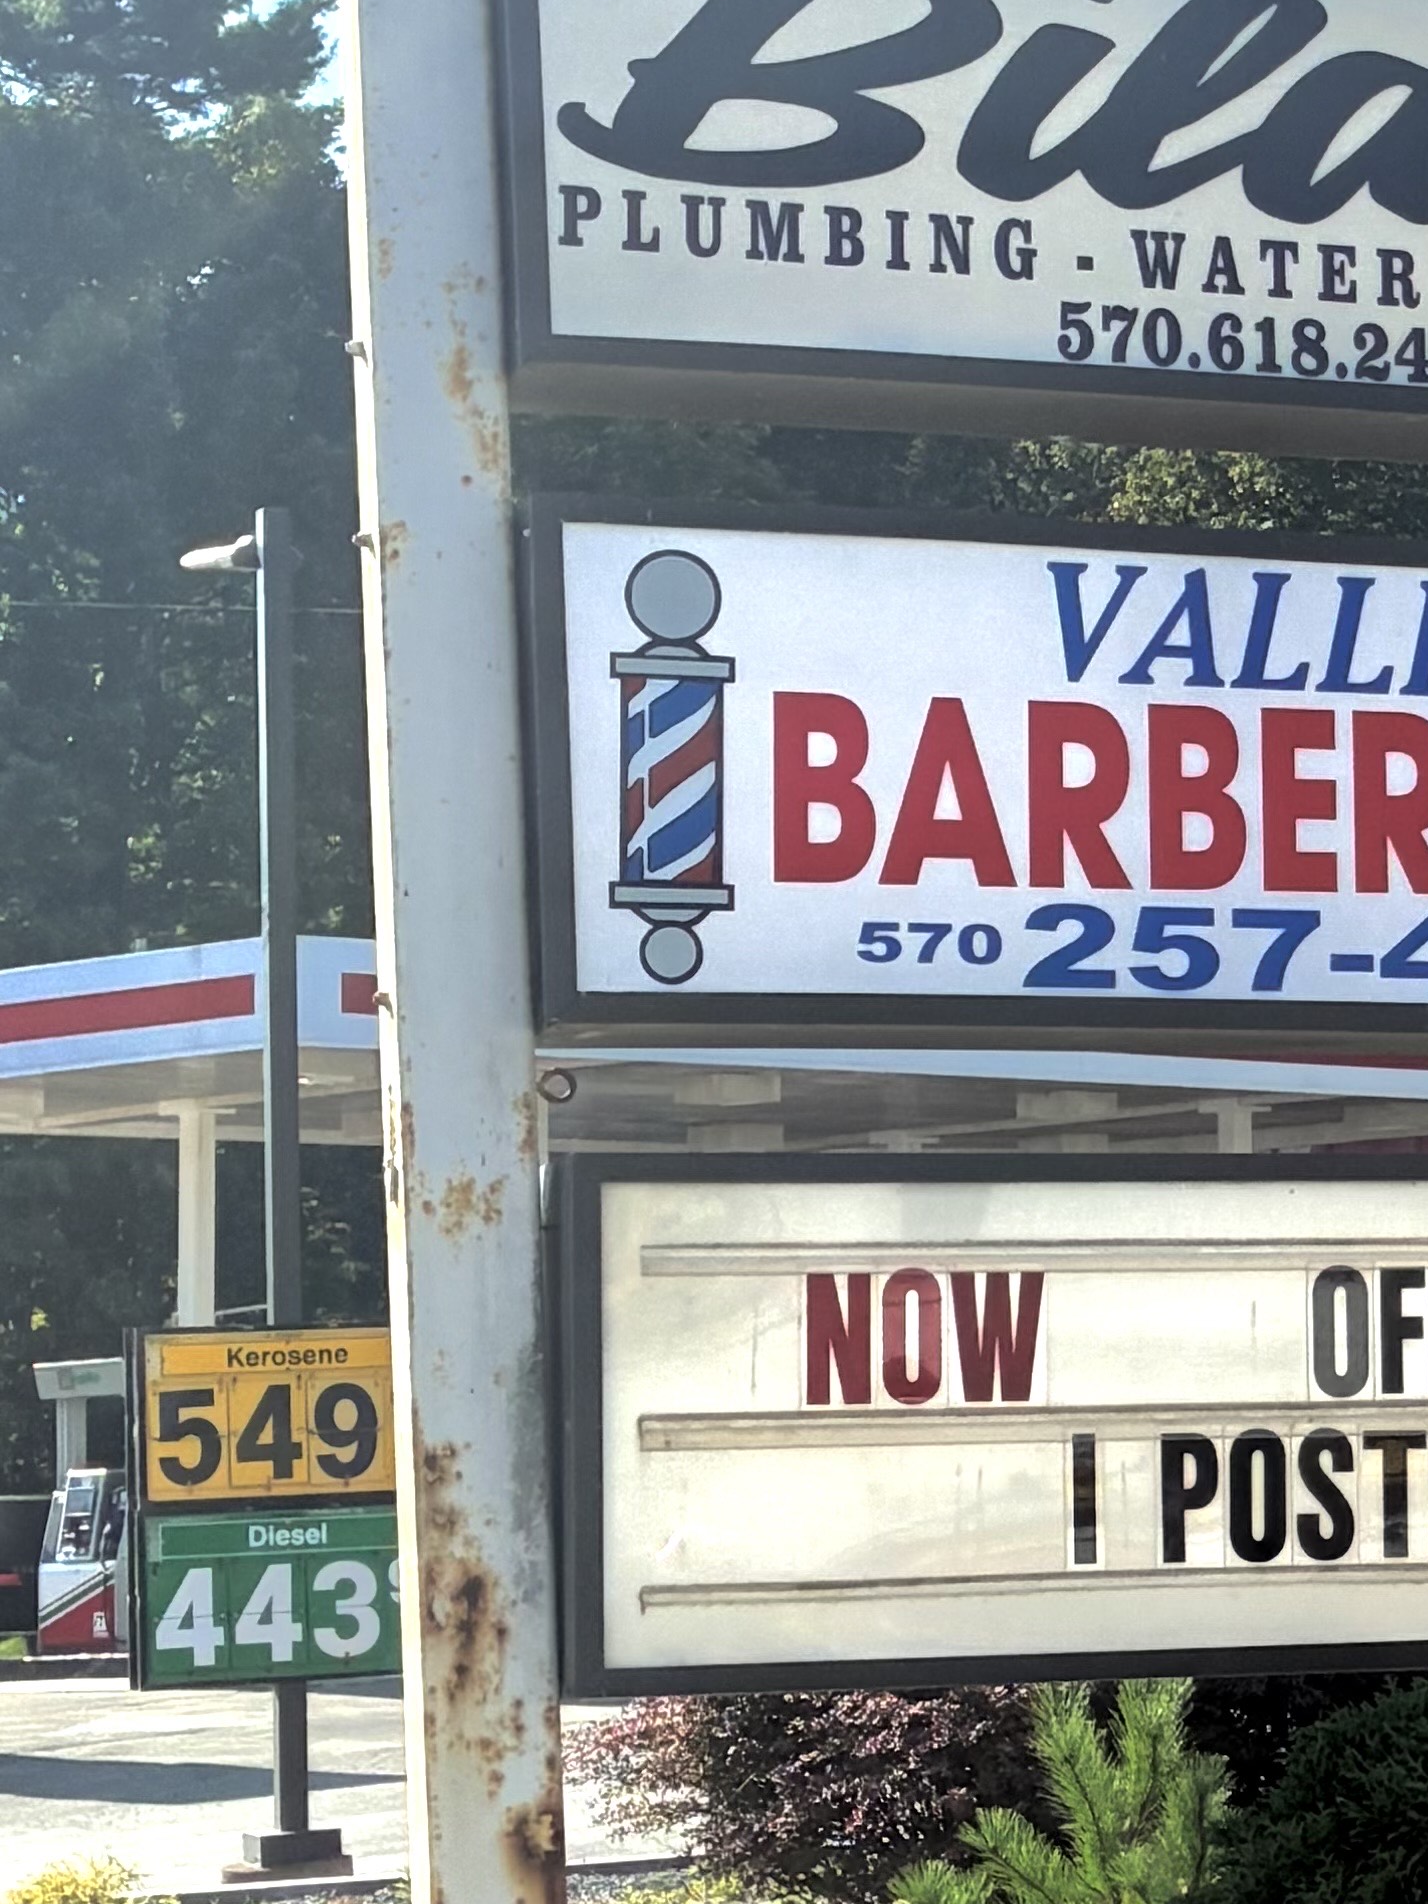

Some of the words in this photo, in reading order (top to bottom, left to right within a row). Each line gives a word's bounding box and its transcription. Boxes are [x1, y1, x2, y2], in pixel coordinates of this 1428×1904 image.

[556, 184, 1040, 284] PLUMBING
[1131, 228, 1422, 310] WATER
[855, 919, 1003, 967] 570
[226, 1346, 349, 1368] Kerosene
[805, 1269, 1046, 1406] NOW
[157, 1382, 379, 1486] 549
[248, 1523, 328, 1548] Diesel
